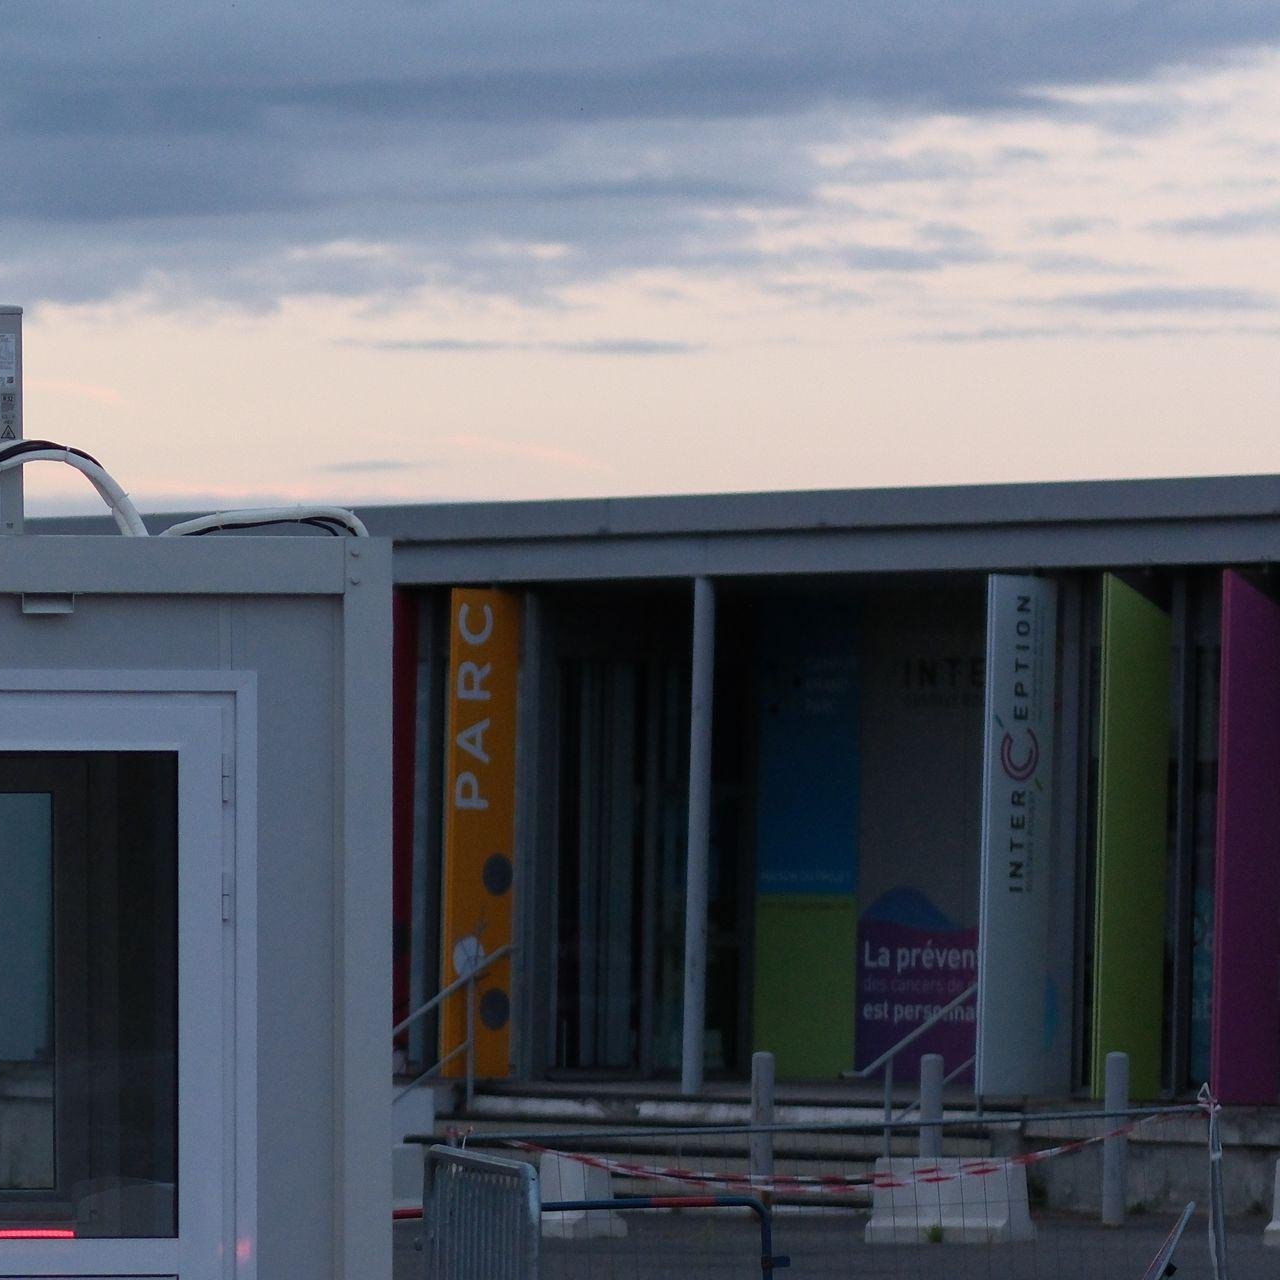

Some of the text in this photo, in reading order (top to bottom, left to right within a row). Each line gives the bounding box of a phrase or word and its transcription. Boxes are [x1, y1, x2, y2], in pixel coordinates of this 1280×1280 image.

[455, 602, 495, 811] PARC
[864, 939, 891, 968] La
[863, 1000, 889, 1021] est
